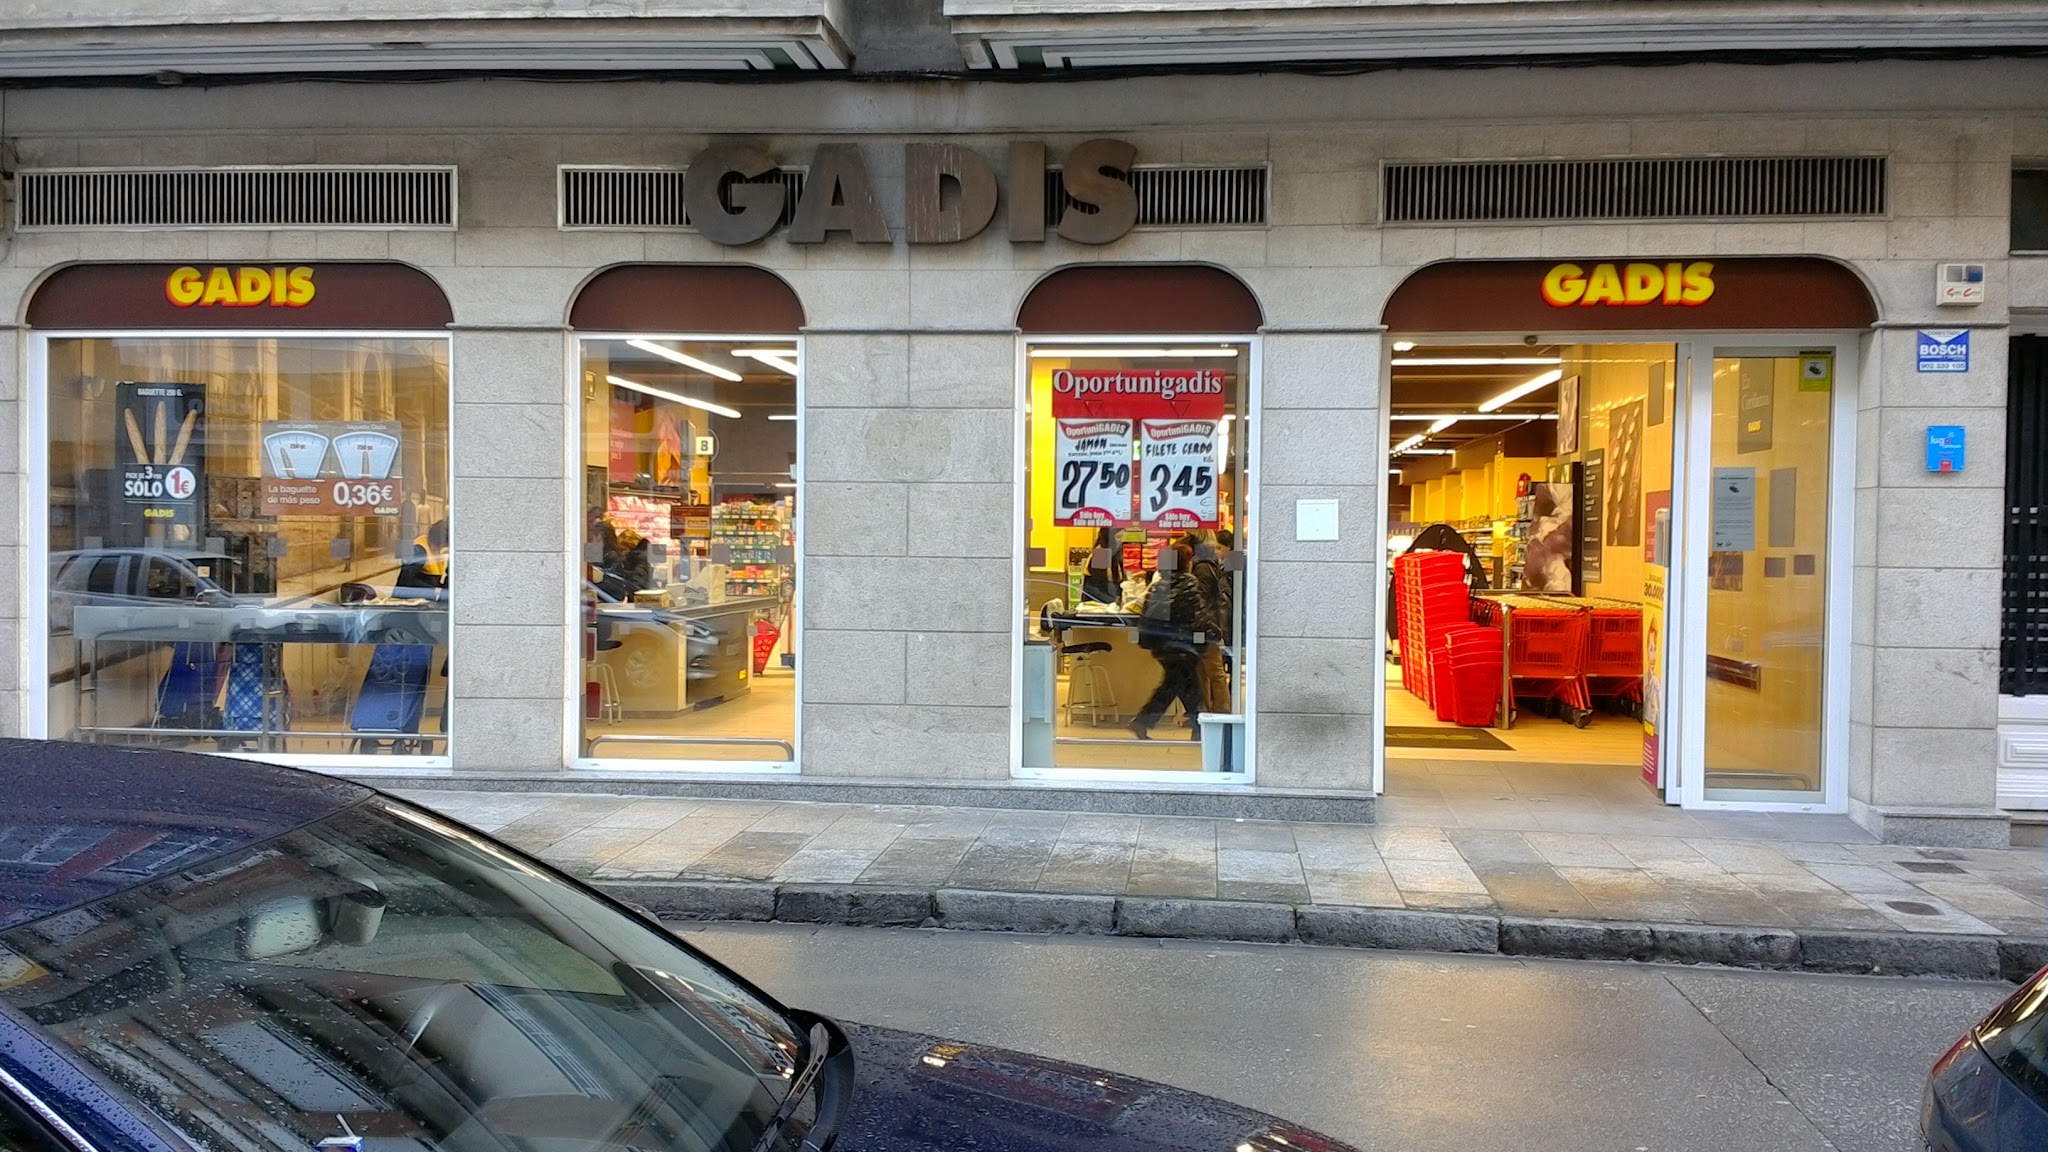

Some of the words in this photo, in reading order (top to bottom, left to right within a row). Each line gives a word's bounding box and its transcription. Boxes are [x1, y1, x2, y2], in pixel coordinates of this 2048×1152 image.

[683, 138, 1138, 246] GADIS
[165, 266, 316, 308] GADIS
[1540, 261, 1716, 308] GADIS
[1920, 344, 1967, 355] BOSCH
[1053, 370, 1222, 399] Oportunigadis
[1065, 422, 1127, 437] OportuniGADIS
[1150, 423, 1212, 438] OportuniGADIS
[1145, 442, 1178, 458] FILETE
[1181, 441, 1213, 456] CERDO
[145, 465, 154, 480] 3
[124, 478, 163, 498] SÓLO
[171, 470, 190, 495] 1€
[268, 485, 279, 493] La
[279, 484, 318, 495] baguette
[267, 495, 279, 504] de
[280, 495, 298, 504] más
[299, 497, 321, 506] peso
[333, 481, 394, 509] 0,36€
[143, 508, 175, 518] GADIS
[374, 506, 399, 515] GADIS
